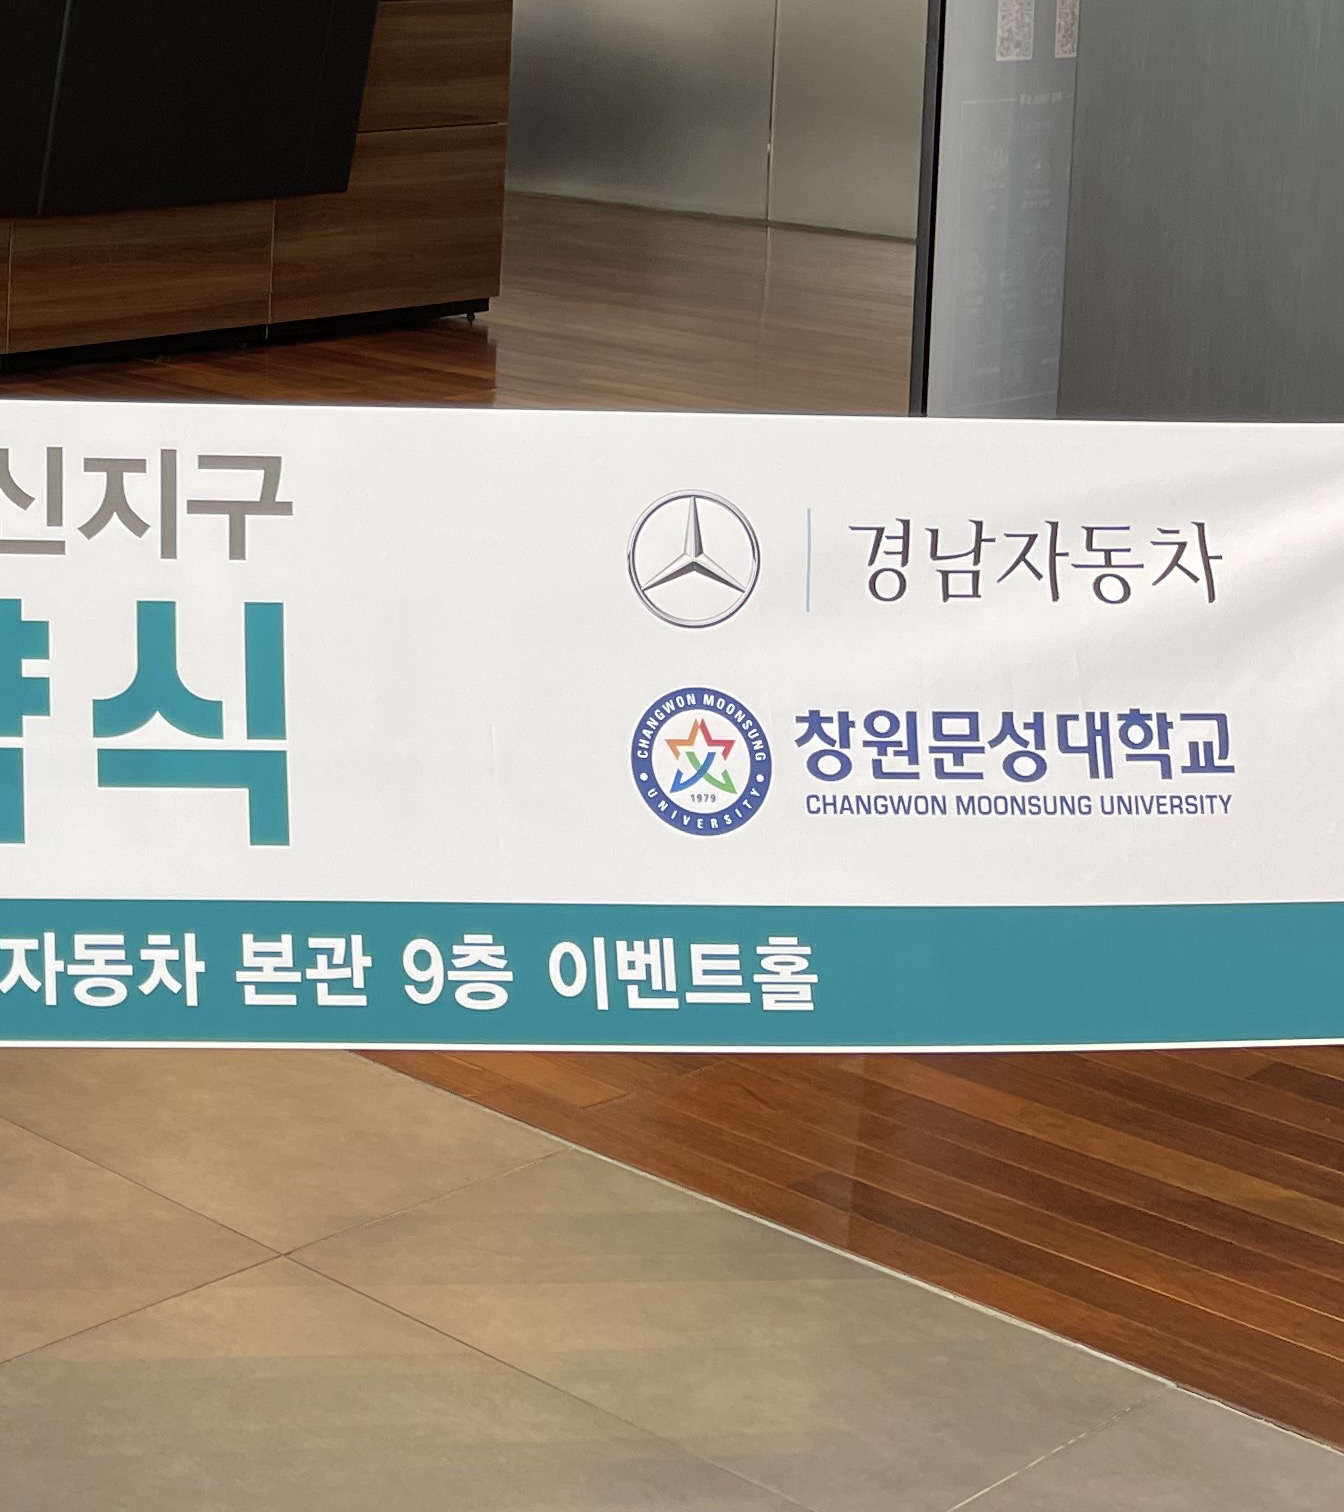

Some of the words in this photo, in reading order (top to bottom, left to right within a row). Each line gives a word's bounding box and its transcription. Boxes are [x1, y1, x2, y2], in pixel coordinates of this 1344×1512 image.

[847, 517, 1225, 606] 경남자동차
[637, 693, 697, 759] CHANGWON
[703, 693, 767, 761] MOONSUNG
[795, 709, 1237, 784] 창원문성대학교
[647, 787, 761, 829] UNIVERSITY
[690, 793, 717, 804] 1979
[805, 794, 948, 817] CHANGWON
[955, 794, 1094, 818] MOONSUNG
[1100, 794, 1234, 817] UNIVERSITY
[235, 933, 375, 1008] 본관
[402, 934, 516, 1012] 9층
[547, 936, 820, 1013] 이벤트홀
